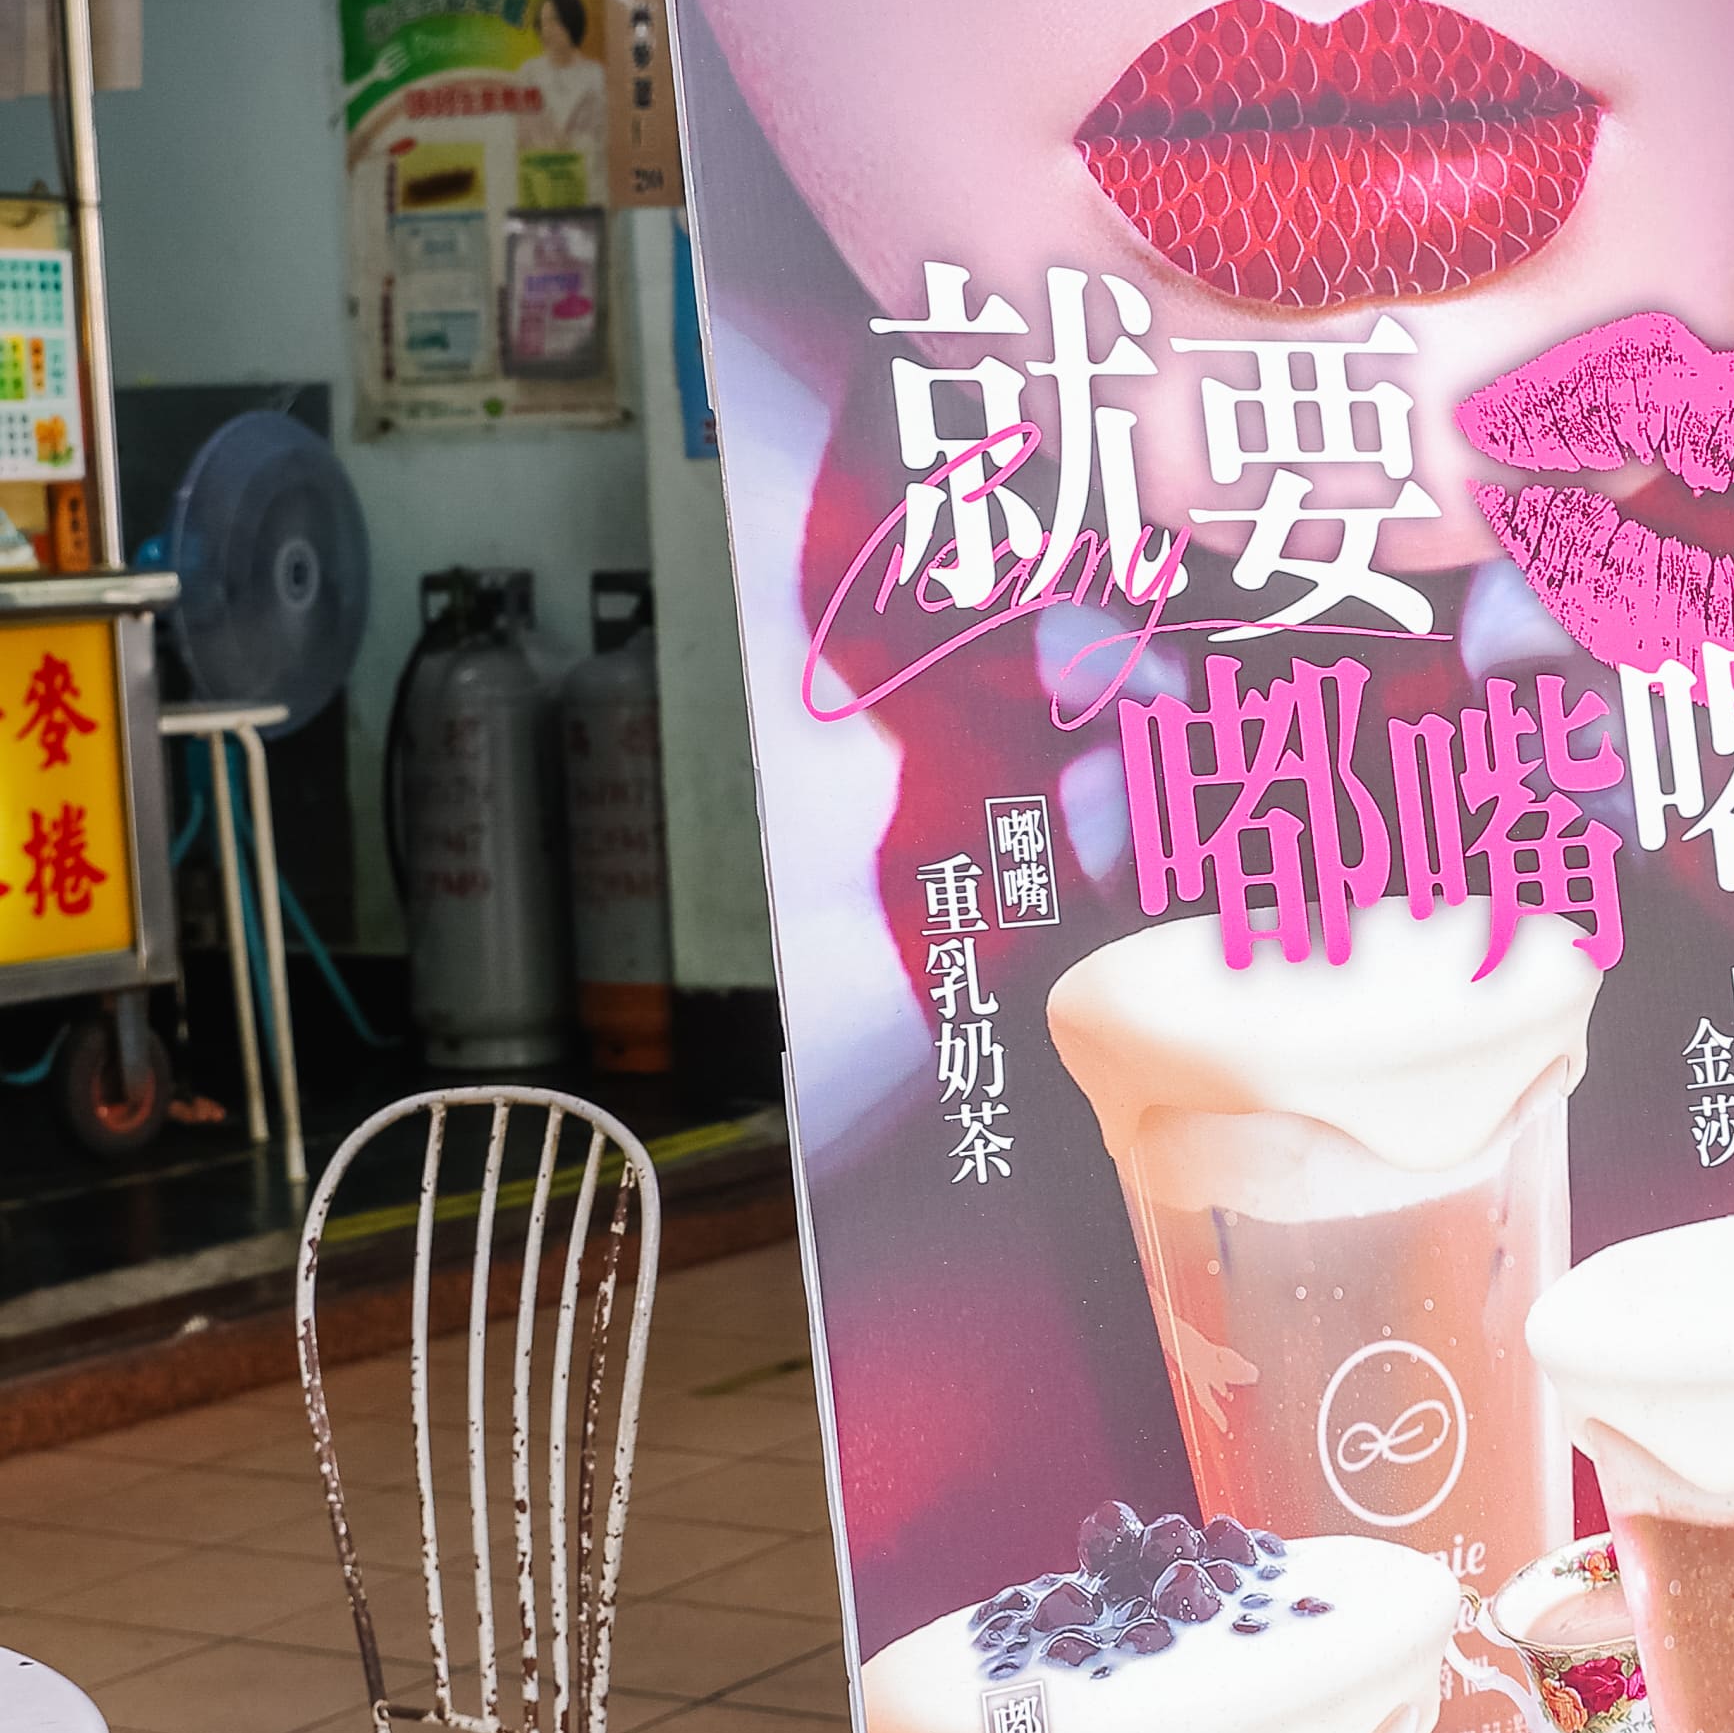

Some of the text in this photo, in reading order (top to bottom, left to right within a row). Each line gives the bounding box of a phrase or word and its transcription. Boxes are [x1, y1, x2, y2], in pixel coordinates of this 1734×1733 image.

[870, 259, 1442, 643] 就要
[915, 852, 1016, 1186] 重乳奶茶
[995, 807, 1049, 919] 嘟嘴
